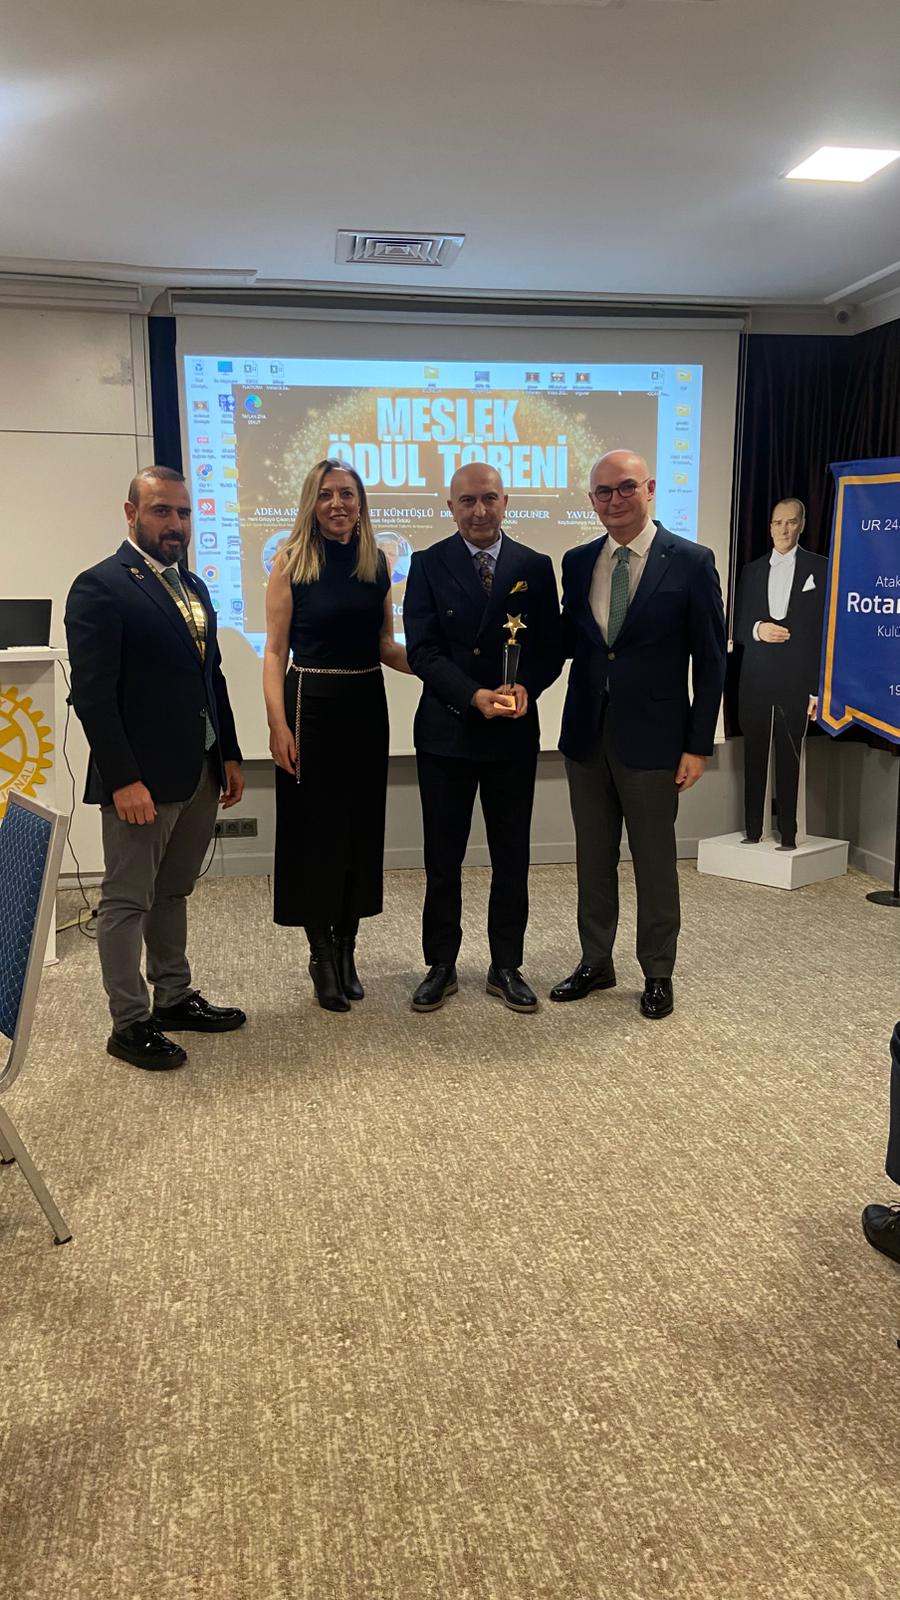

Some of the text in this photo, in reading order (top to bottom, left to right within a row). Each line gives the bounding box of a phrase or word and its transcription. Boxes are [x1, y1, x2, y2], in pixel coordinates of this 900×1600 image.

[376, 397, 520, 442] MESLEK
[254, 507, 282, 516] ADEM
[566, 510, 596, 519] YAVUZ
[861, 518, 900, 531] UR 24
